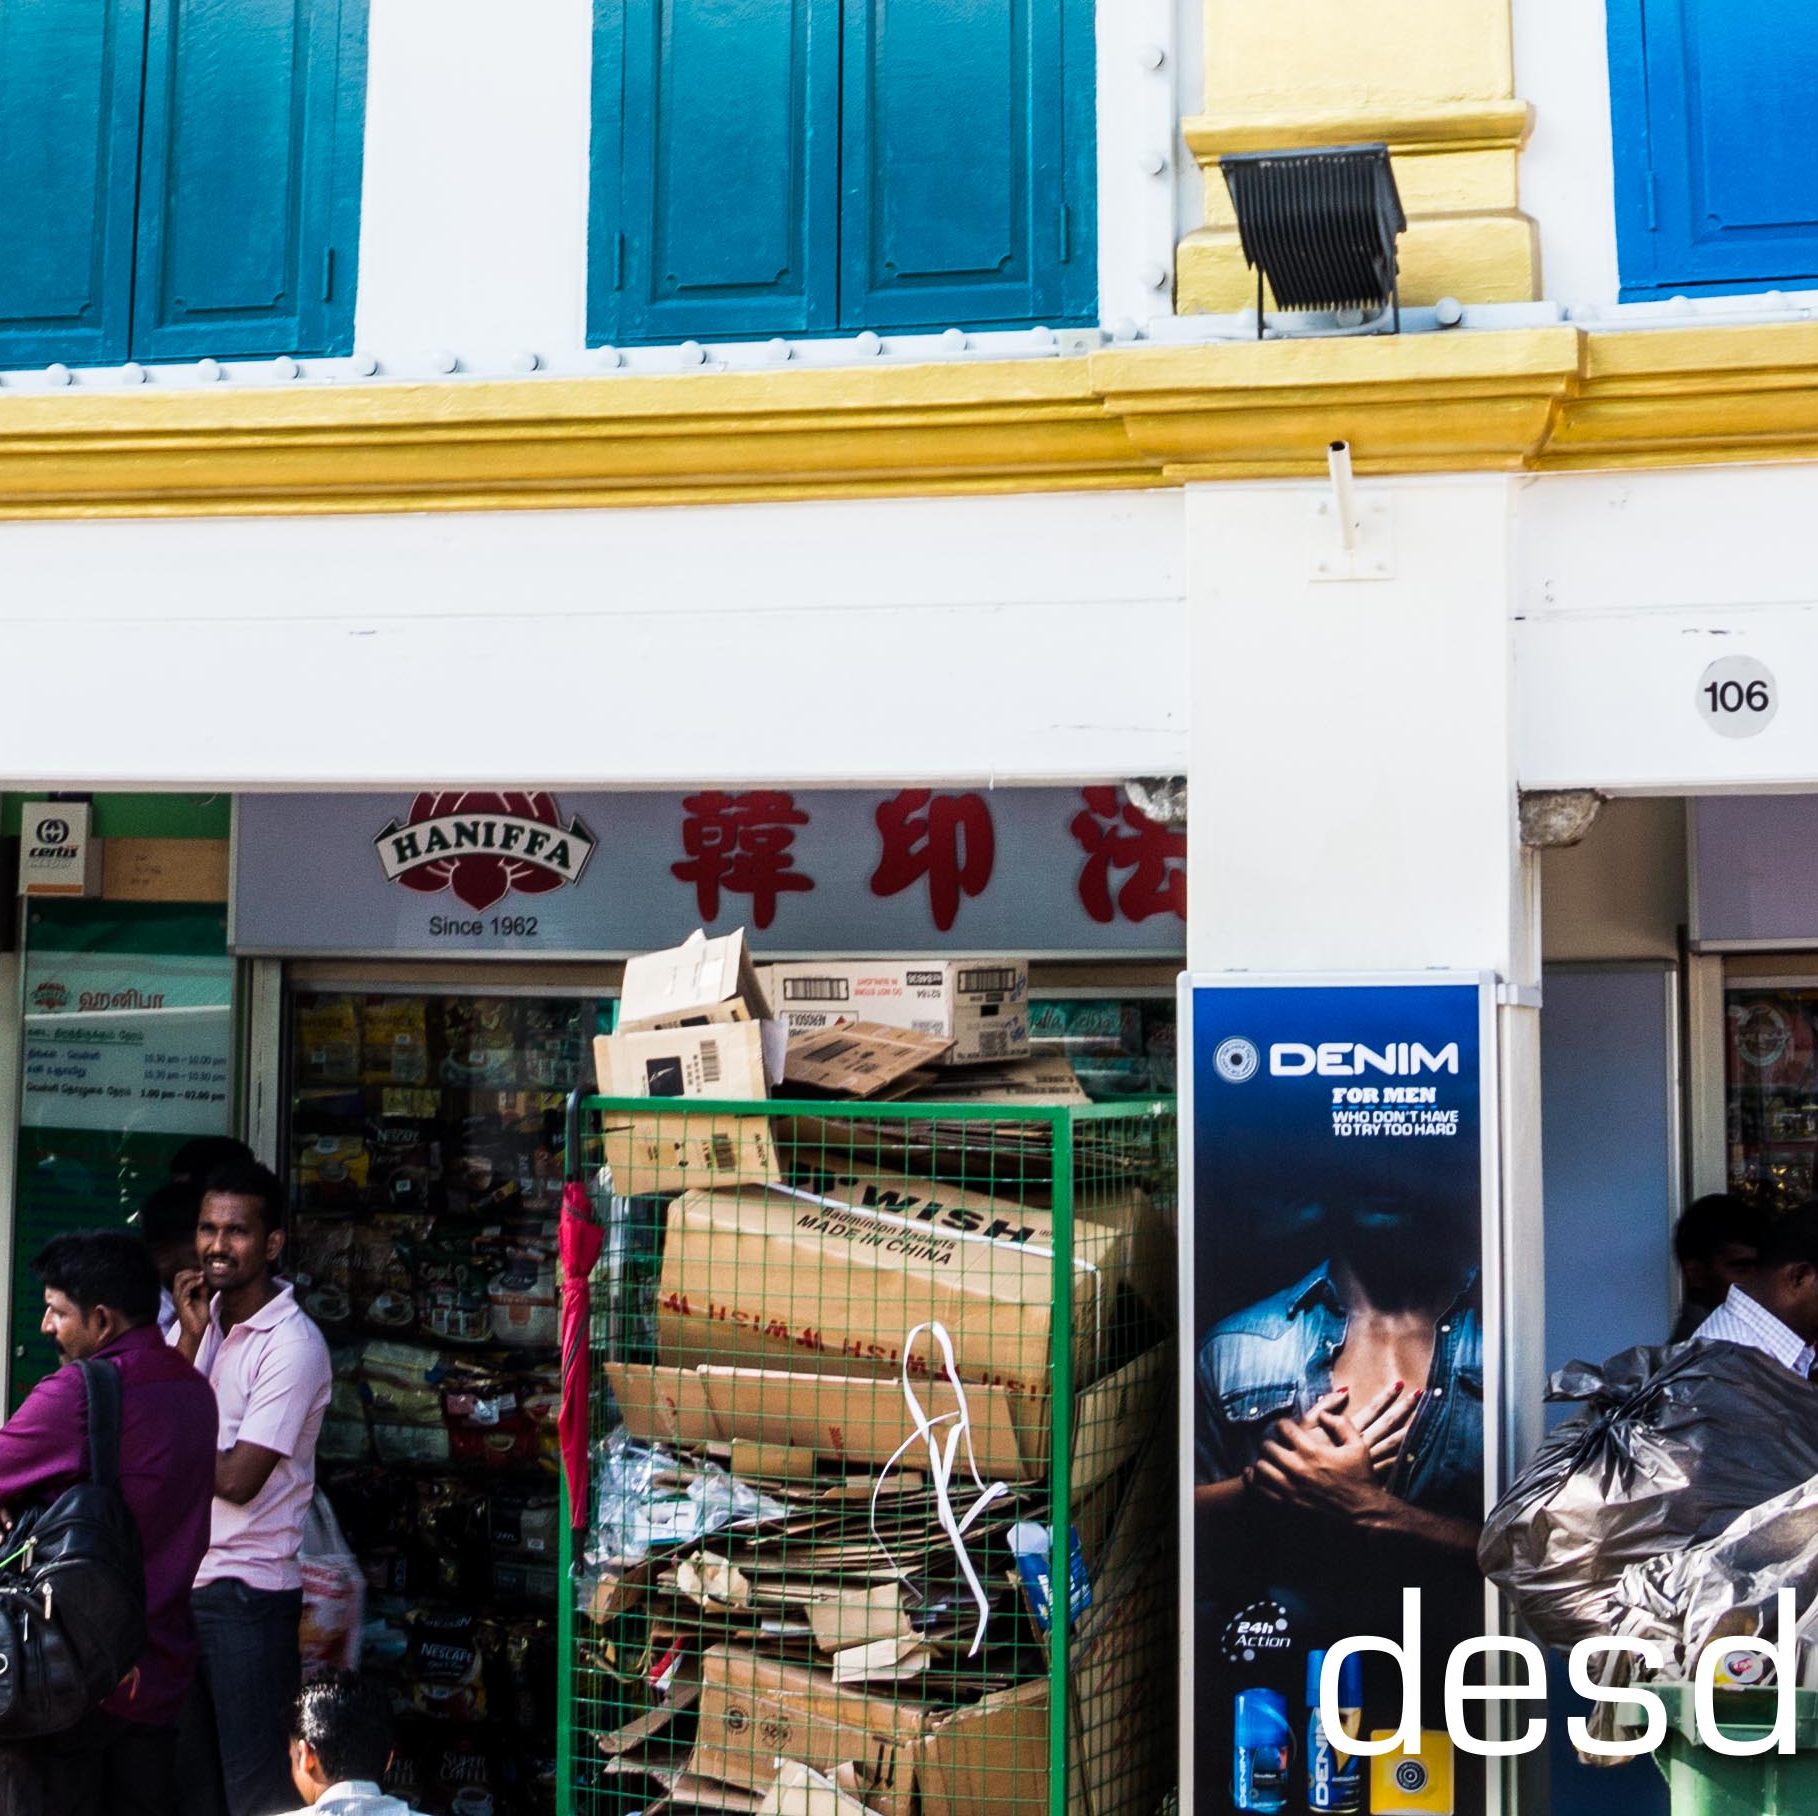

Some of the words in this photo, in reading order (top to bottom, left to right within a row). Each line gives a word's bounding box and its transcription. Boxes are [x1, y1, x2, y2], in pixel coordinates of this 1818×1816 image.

[1704, 678, 1770, 714] 106
[29, 846, 79, 860] certis
[391, 820, 572, 870] HANIFFA
[428, 915, 485, 936] Since
[490, 916, 539, 936] 1962
[1269, 1042, 1460, 1076] DENIM
[1331, 1087, 1380, 1104] FOR
[1383, 1087, 1437, 1104] MEN
[1331, 1110, 1370, 1124] WHO
[1372, 1110, 1419, 1123] DON'T
[1421, 1110, 1460, 1123] HAVE
[1332, 1123, 1353, 1137] TO
[1353, 1123, 1382, 1137] TRY
[1383, 1123, 1414, 1136] TOO
[1414, 1123, 1457, 1136] HARD
[861, 1185, 1036, 1243] WISH
[796, 1213, 861, 1241] MADE
[860, 1232, 883, 1249] IN
[885, 1238, 953, 1266] CHINA
[1237, 1621, 1274, 1635] 24h
[1234, 1634, 1291, 1648] Action
